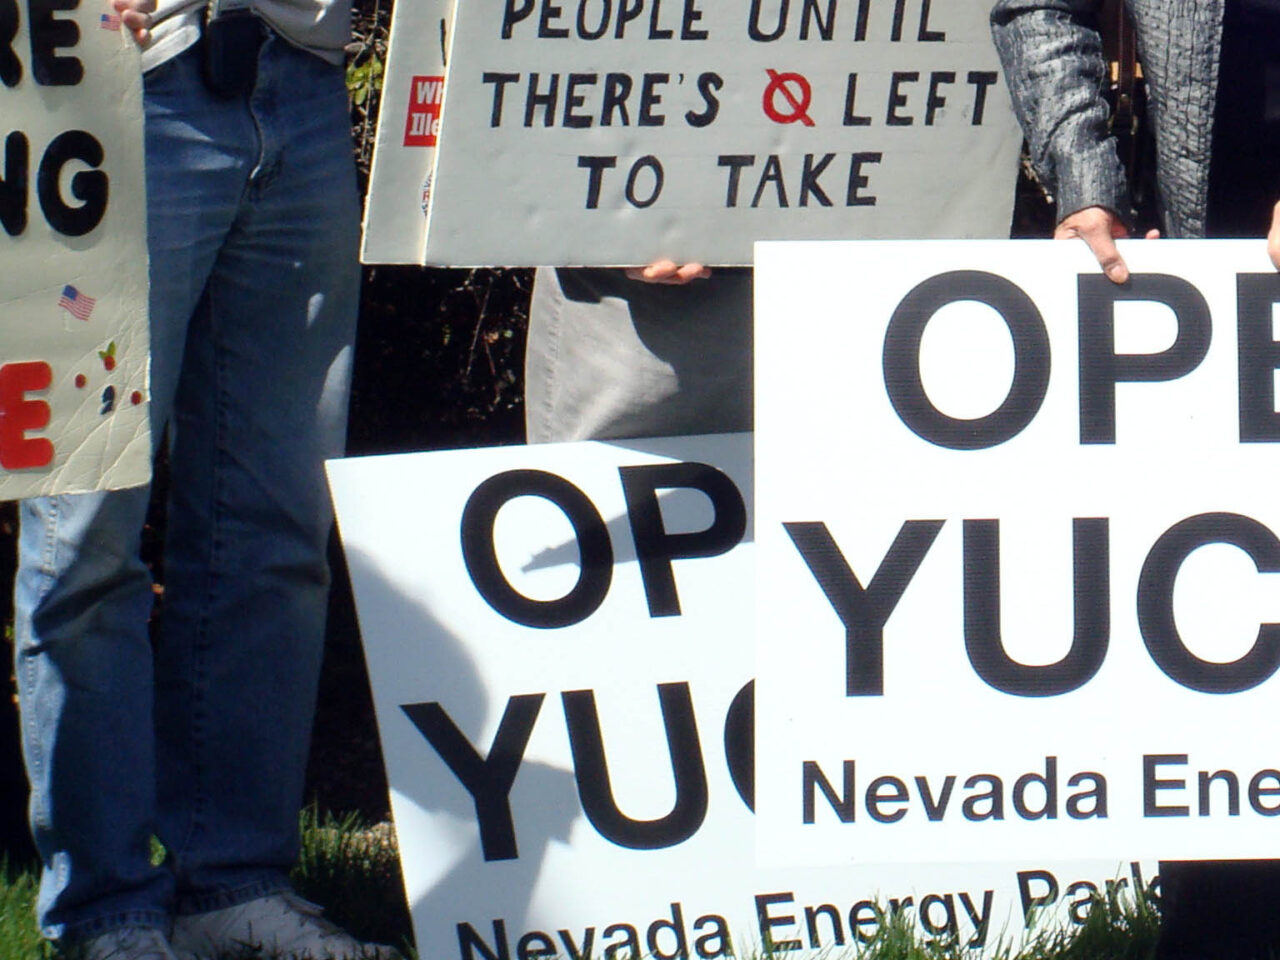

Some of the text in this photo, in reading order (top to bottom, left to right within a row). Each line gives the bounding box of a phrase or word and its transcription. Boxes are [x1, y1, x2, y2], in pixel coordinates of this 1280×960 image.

[482, 71, 723, 129] THERE'S
[842, 71, 998, 127] LEFT
[578, 152, 883, 209] TO TAKE
[460, 461, 748, 630] OP
[399, 678, 755, 862] YU
[801, 756, 1109, 825] Nevada
[754, 890, 994, 952] Energy
